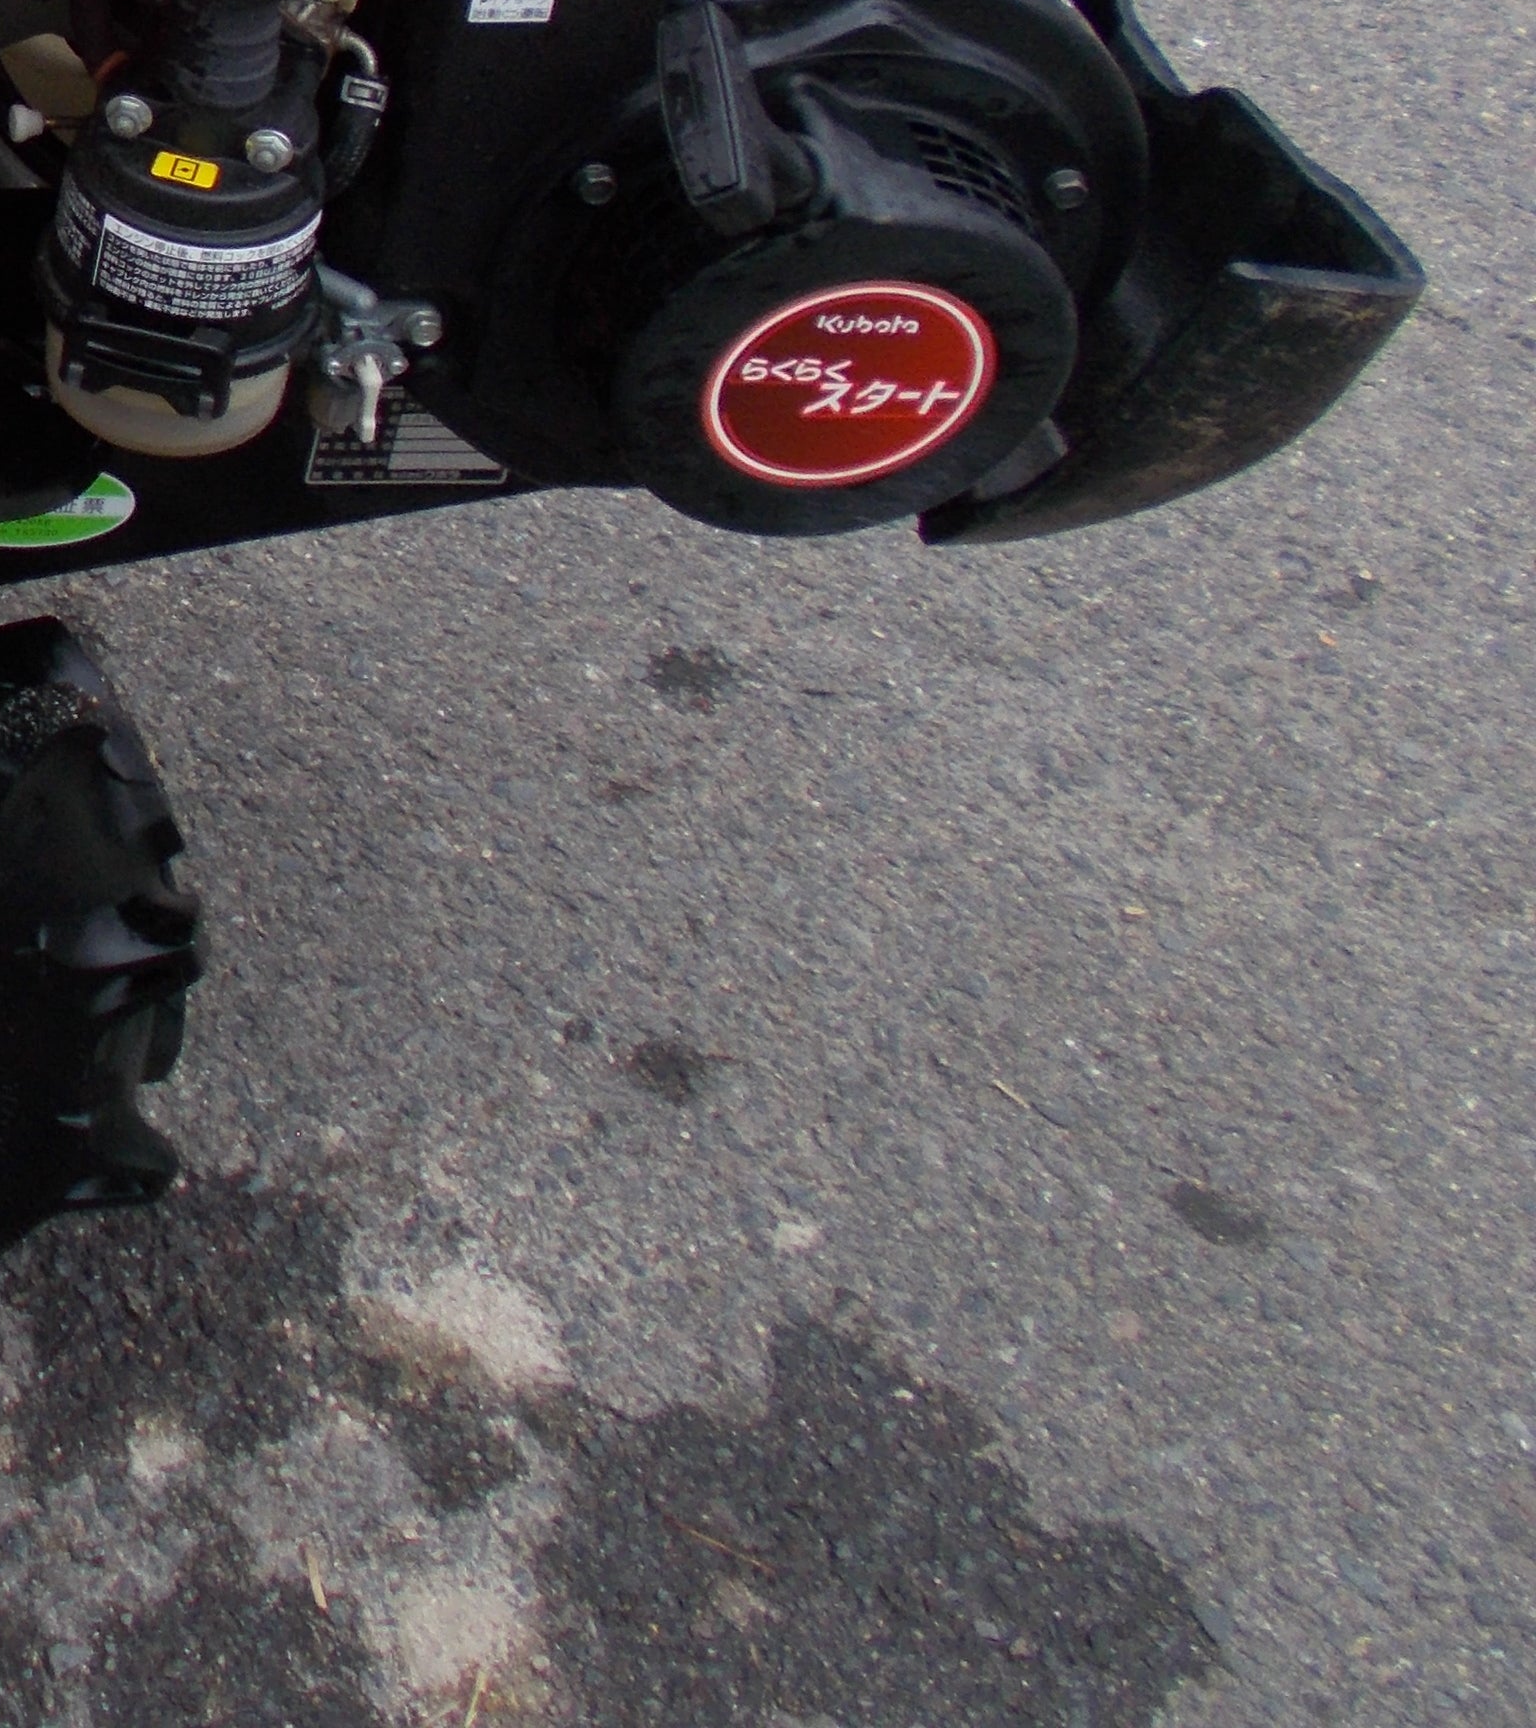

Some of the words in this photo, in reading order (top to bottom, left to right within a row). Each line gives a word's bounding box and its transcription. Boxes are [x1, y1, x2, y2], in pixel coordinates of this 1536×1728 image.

[741, 357, 853, 382] らくらく
[802, 380, 960, 415] スタート
